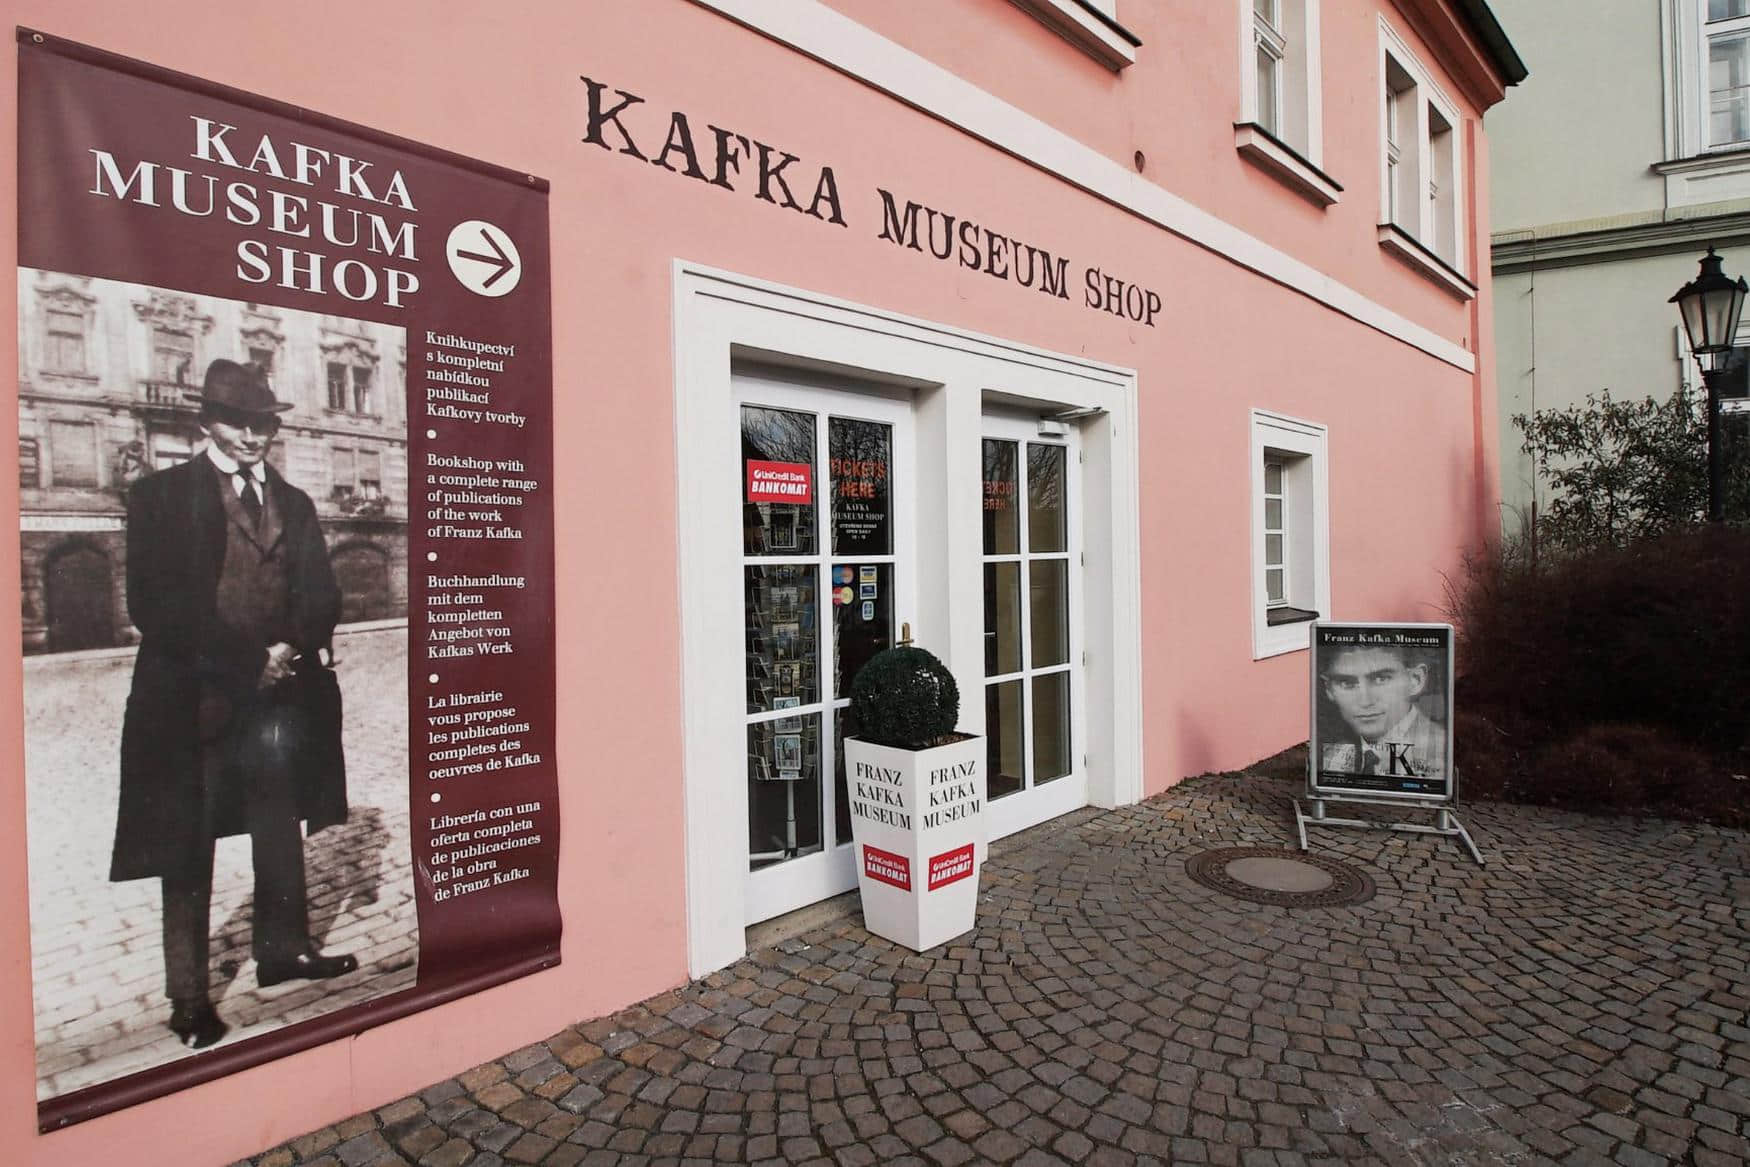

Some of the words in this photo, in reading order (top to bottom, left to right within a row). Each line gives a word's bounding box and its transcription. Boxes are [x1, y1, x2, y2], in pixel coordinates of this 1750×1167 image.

[190, 115, 418, 211] KAFKA
[89, 149, 419, 261] MUSEUM
[580, 75, 848, 228] KAFKA
[876, 187, 1071, 301] MUSEUM
[1084, 267, 1162, 327] SHOP
[237, 240, 420, 308] SHOP
[426, 331, 514, 356] Knihkupectví
[426, 352, 434, 361] s
[437, 351, 504, 372] kompletní
[427, 369, 490, 387] nabídkou
[427, 387, 489, 404] publikací
[427, 403, 482, 423] Kafkovy
[486, 411, 526, 428] tvorby
[427, 453, 493, 472] Bookshop
[496, 460, 524, 472] with
[427, 475, 436, 484] a
[439, 474, 499, 489] complete
[502, 480, 538, 492] range
[752, 481, 808, 495] BANKOMAT
[840, 481, 876, 499] HERE
[427, 490, 442, 502] of
[444, 491, 523, 505] publications
[427, 508, 442, 519] of
[444, 508, 465, 520] the
[469, 510, 503, 521] work
[427, 525, 443, 537] of
[444, 526, 483, 538] Franz
[486, 527, 522, 539] Kafka
[428, 574, 525, 588] Buchhandlung
[428, 593, 451, 605] mit
[454, 592, 483, 604] dem
[428, 609, 502, 624] kompletten
[428, 627, 483, 642] Angebot
[486, 627, 511, 637] von
[1324, 633, 1354, 642] Franz
[1358, 633, 1391, 643] Kafka
[1395, 634, 1440, 644] Museum
[428, 645, 474, 659] Kafkas
[477, 642, 513, 655] Werk
[428, 696, 446, 709] La
[450, 691, 503, 706] librairie
[428, 714, 461, 726] vous
[464, 707, 516, 725] propose
[428, 732, 448, 744] les
[451, 722, 530, 744] publications
[428, 744, 497, 761] completes
[499, 740, 521, 752] des
[429, 763, 483, 779] oeuvres
[486, 758, 502, 771] de
[504, 753, 541, 768] Kafka
[856, 762, 902, 787] FRANZ
[930, 760, 976, 786] FRANZ
[857, 782, 904, 808] KAFKA
[930, 781, 975, 807] KAFKA
[430, 810, 486, 830] Librería
[489, 807, 513, 819] con
[517, 801, 541, 814] una
[853, 801, 912, 830] MUSEUM
[923, 799, 980, 830] MUSEUM
[431, 832, 470, 847] oferta
[474, 820, 533, 839] completa
[431, 853, 448, 865] de
[451, 835, 541, 864] publicaciones
[432, 871, 448, 883] de
[452, 866, 464, 879] la
[467, 860, 497, 874] obra
[867, 862, 908, 883] BANKOMAT
[931, 860, 972, 884] BANKOMAT
[434, 889, 450, 902] de
[453, 878, 490, 897] Franz
[494, 868, 529, 885] Kafka
